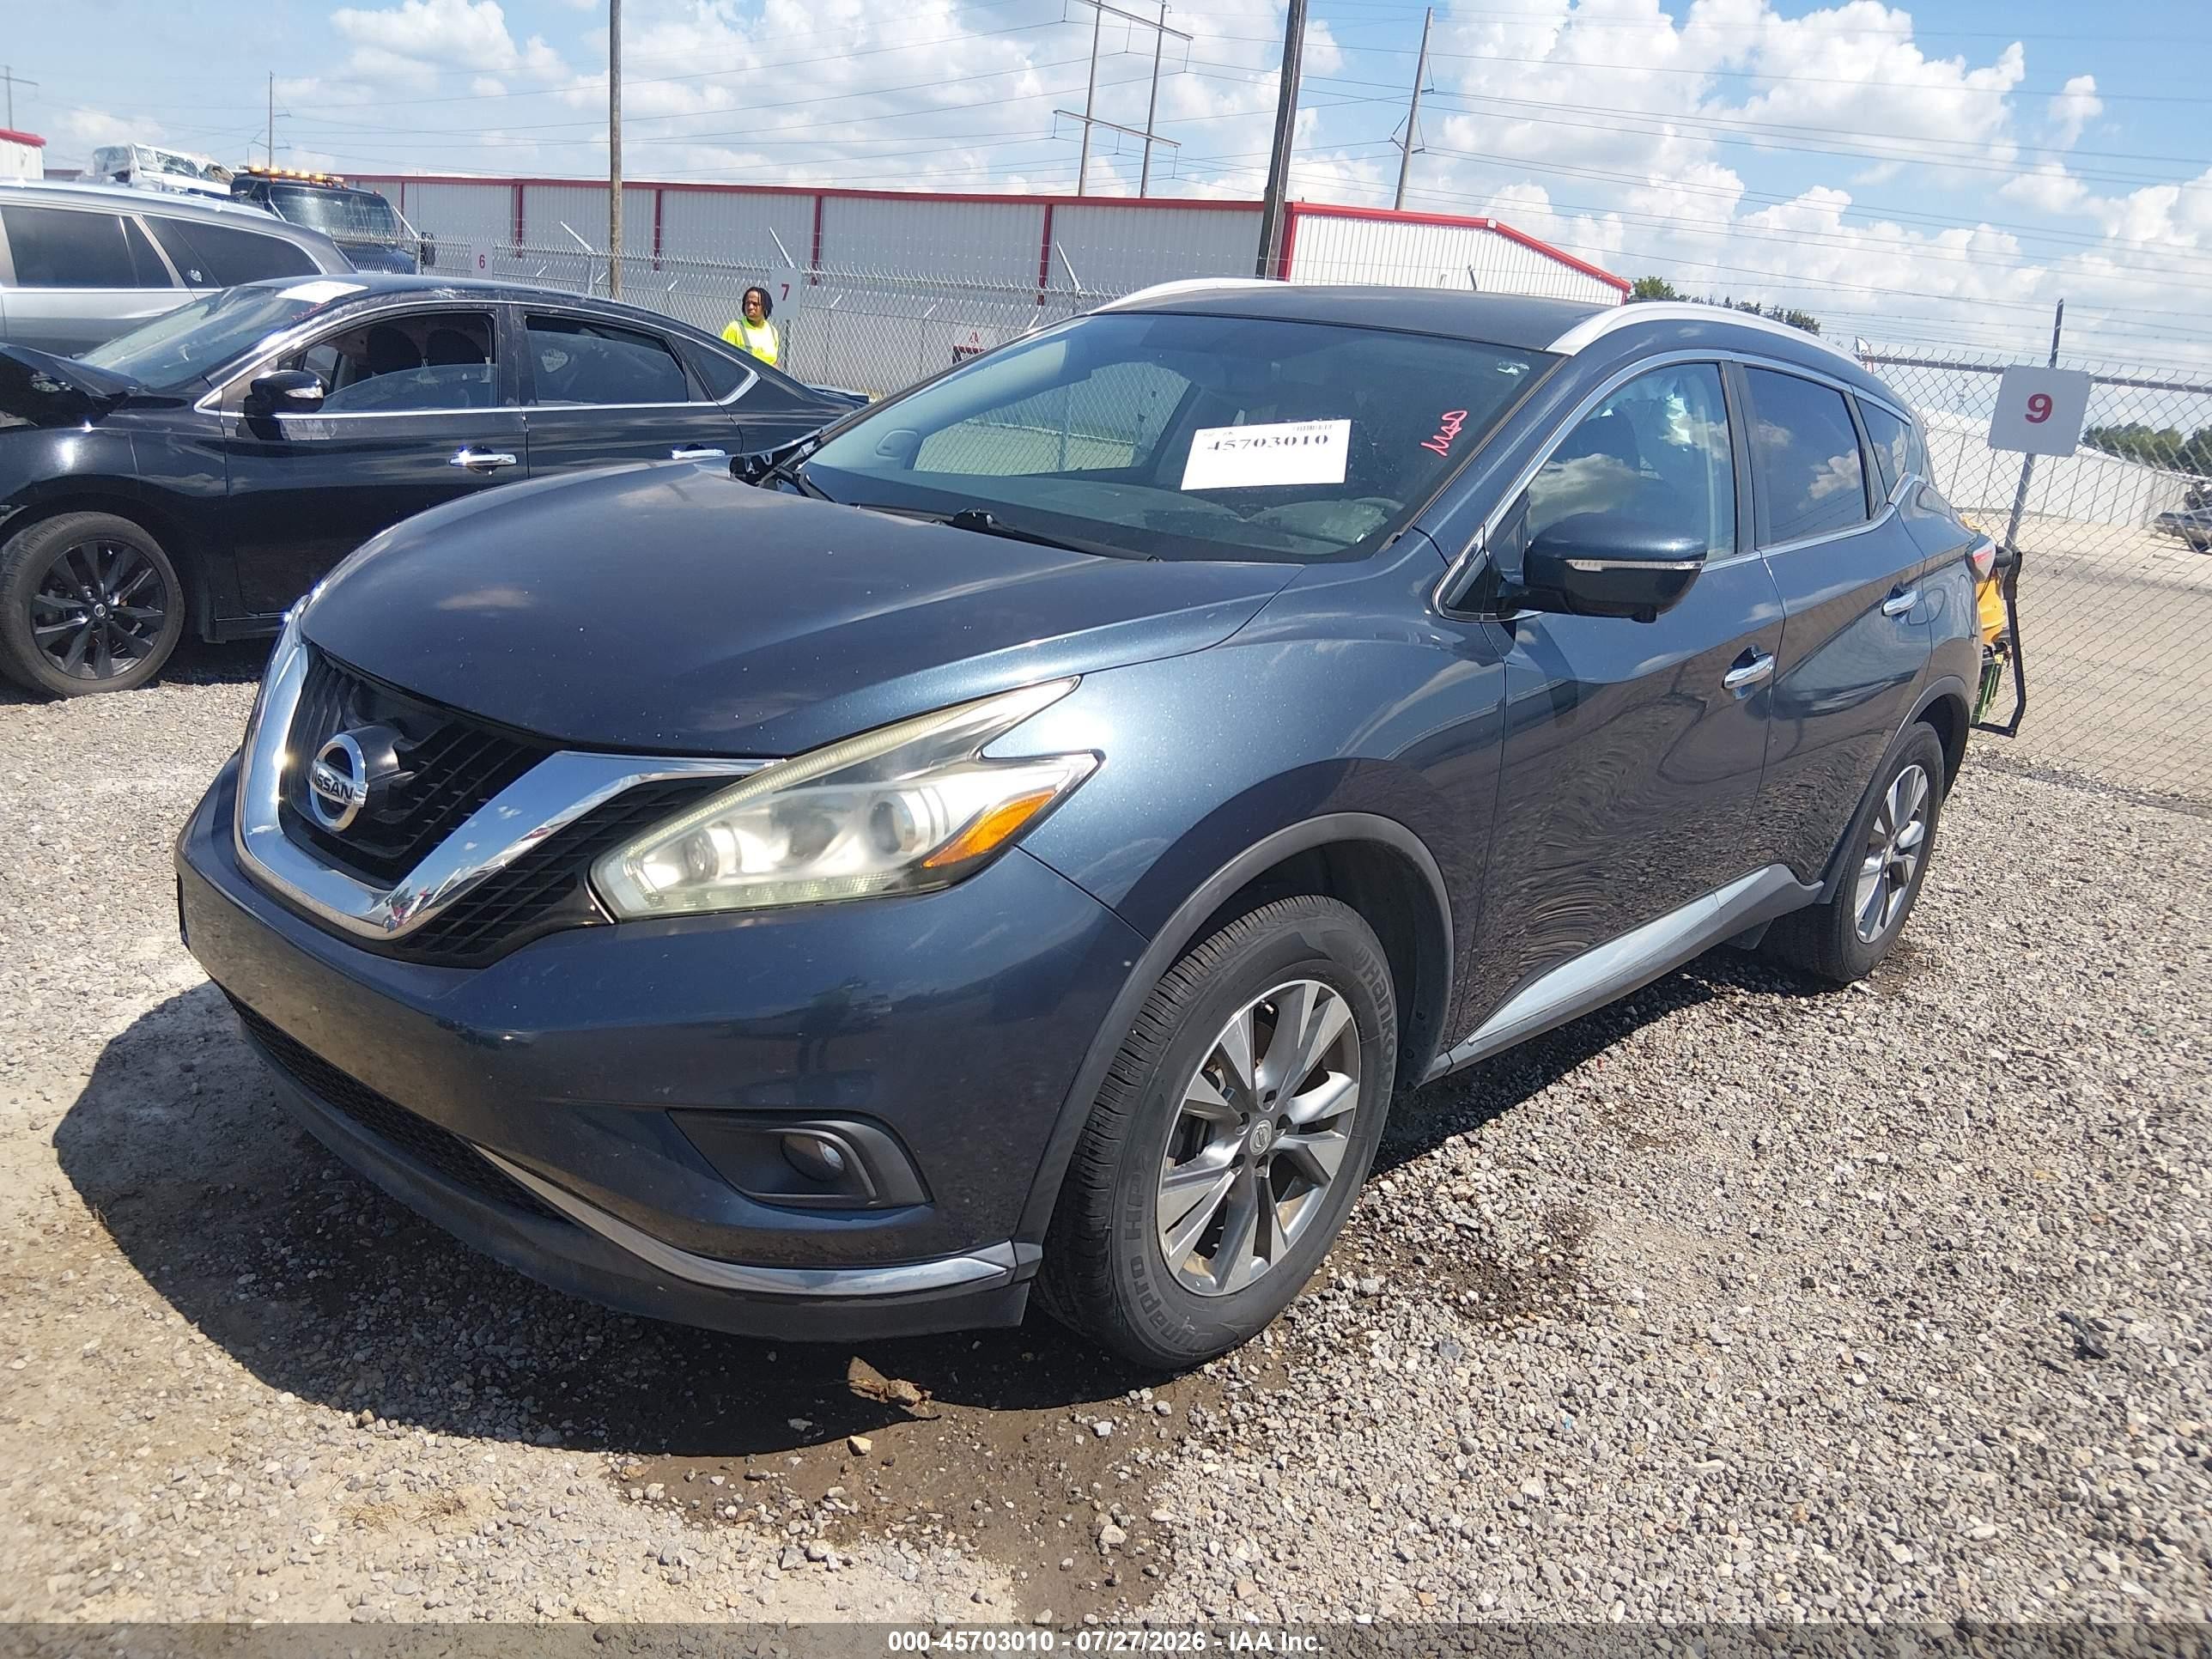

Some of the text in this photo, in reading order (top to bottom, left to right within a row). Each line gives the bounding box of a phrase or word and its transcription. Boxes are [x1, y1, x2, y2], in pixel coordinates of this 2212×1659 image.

[478, 254, 486, 269] 6
[781, 283, 790, 301] 7
[2025, 393, 2053, 423] 9
[1206, 434, 1328, 451] 45703010
